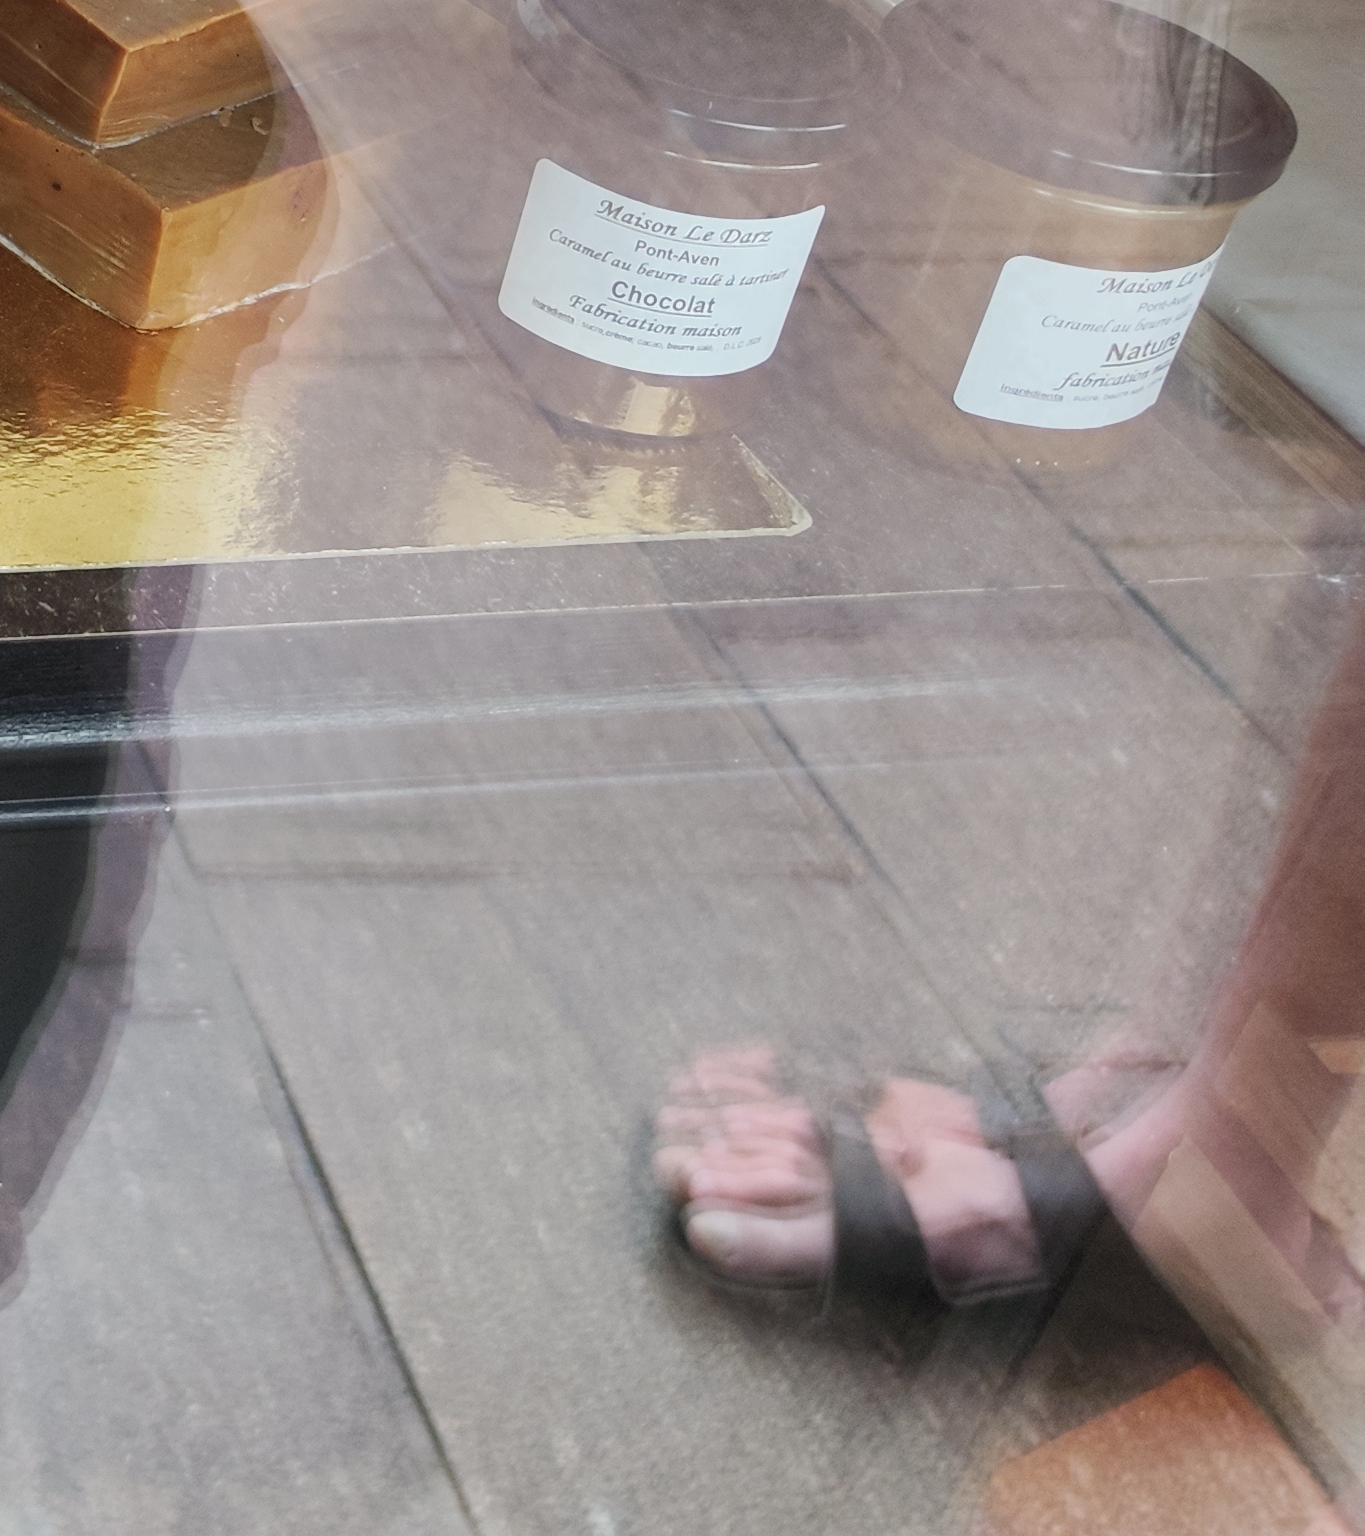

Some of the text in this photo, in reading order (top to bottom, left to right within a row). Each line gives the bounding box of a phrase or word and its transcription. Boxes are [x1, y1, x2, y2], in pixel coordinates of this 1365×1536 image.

[596, 199, 773, 244] Maison Le Darz
[549, 228, 612, 263] Caramel
[611, 255, 632, 272] au
[637, 263, 687, 283] beurre
[690, 270, 721, 286] salé
[739, 268, 789, 286] tartiner
[635, 240, 720, 266] Pont-Aven
[611, 281, 716, 314] Chocolat
[1097, 277, 1172, 294] Maison
[569, 295, 677, 337] Fabrication
[682, 324, 742, 338] maison
[1041, 315, 1113, 333] Caramel
[1111, 322, 1130, 333] au
[1105, 331, 1180, 362] Nature
[1052, 369, 1149, 391] fabrication
